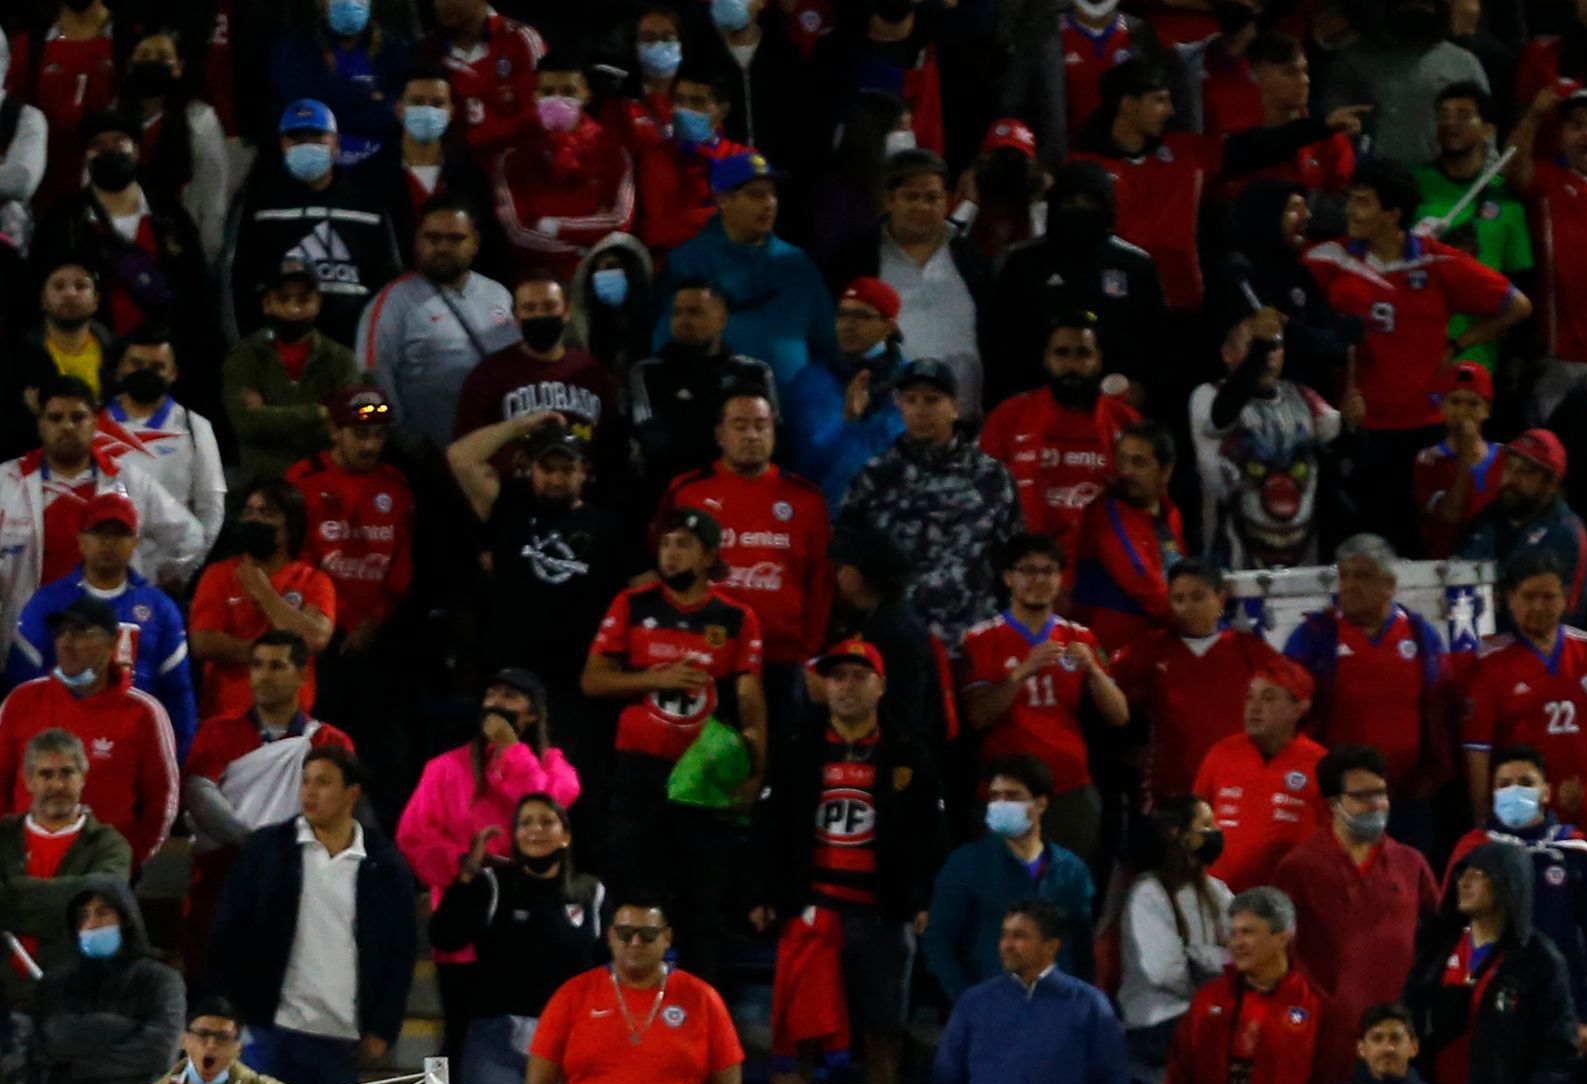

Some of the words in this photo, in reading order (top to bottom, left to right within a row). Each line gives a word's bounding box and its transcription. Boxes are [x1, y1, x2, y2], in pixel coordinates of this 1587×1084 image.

[1372, 302, 1395, 333] 9
[1025, 675, 1057, 707] 11
[1545, 701, 1580, 735] 22
[823, 801, 868, 833] PF
